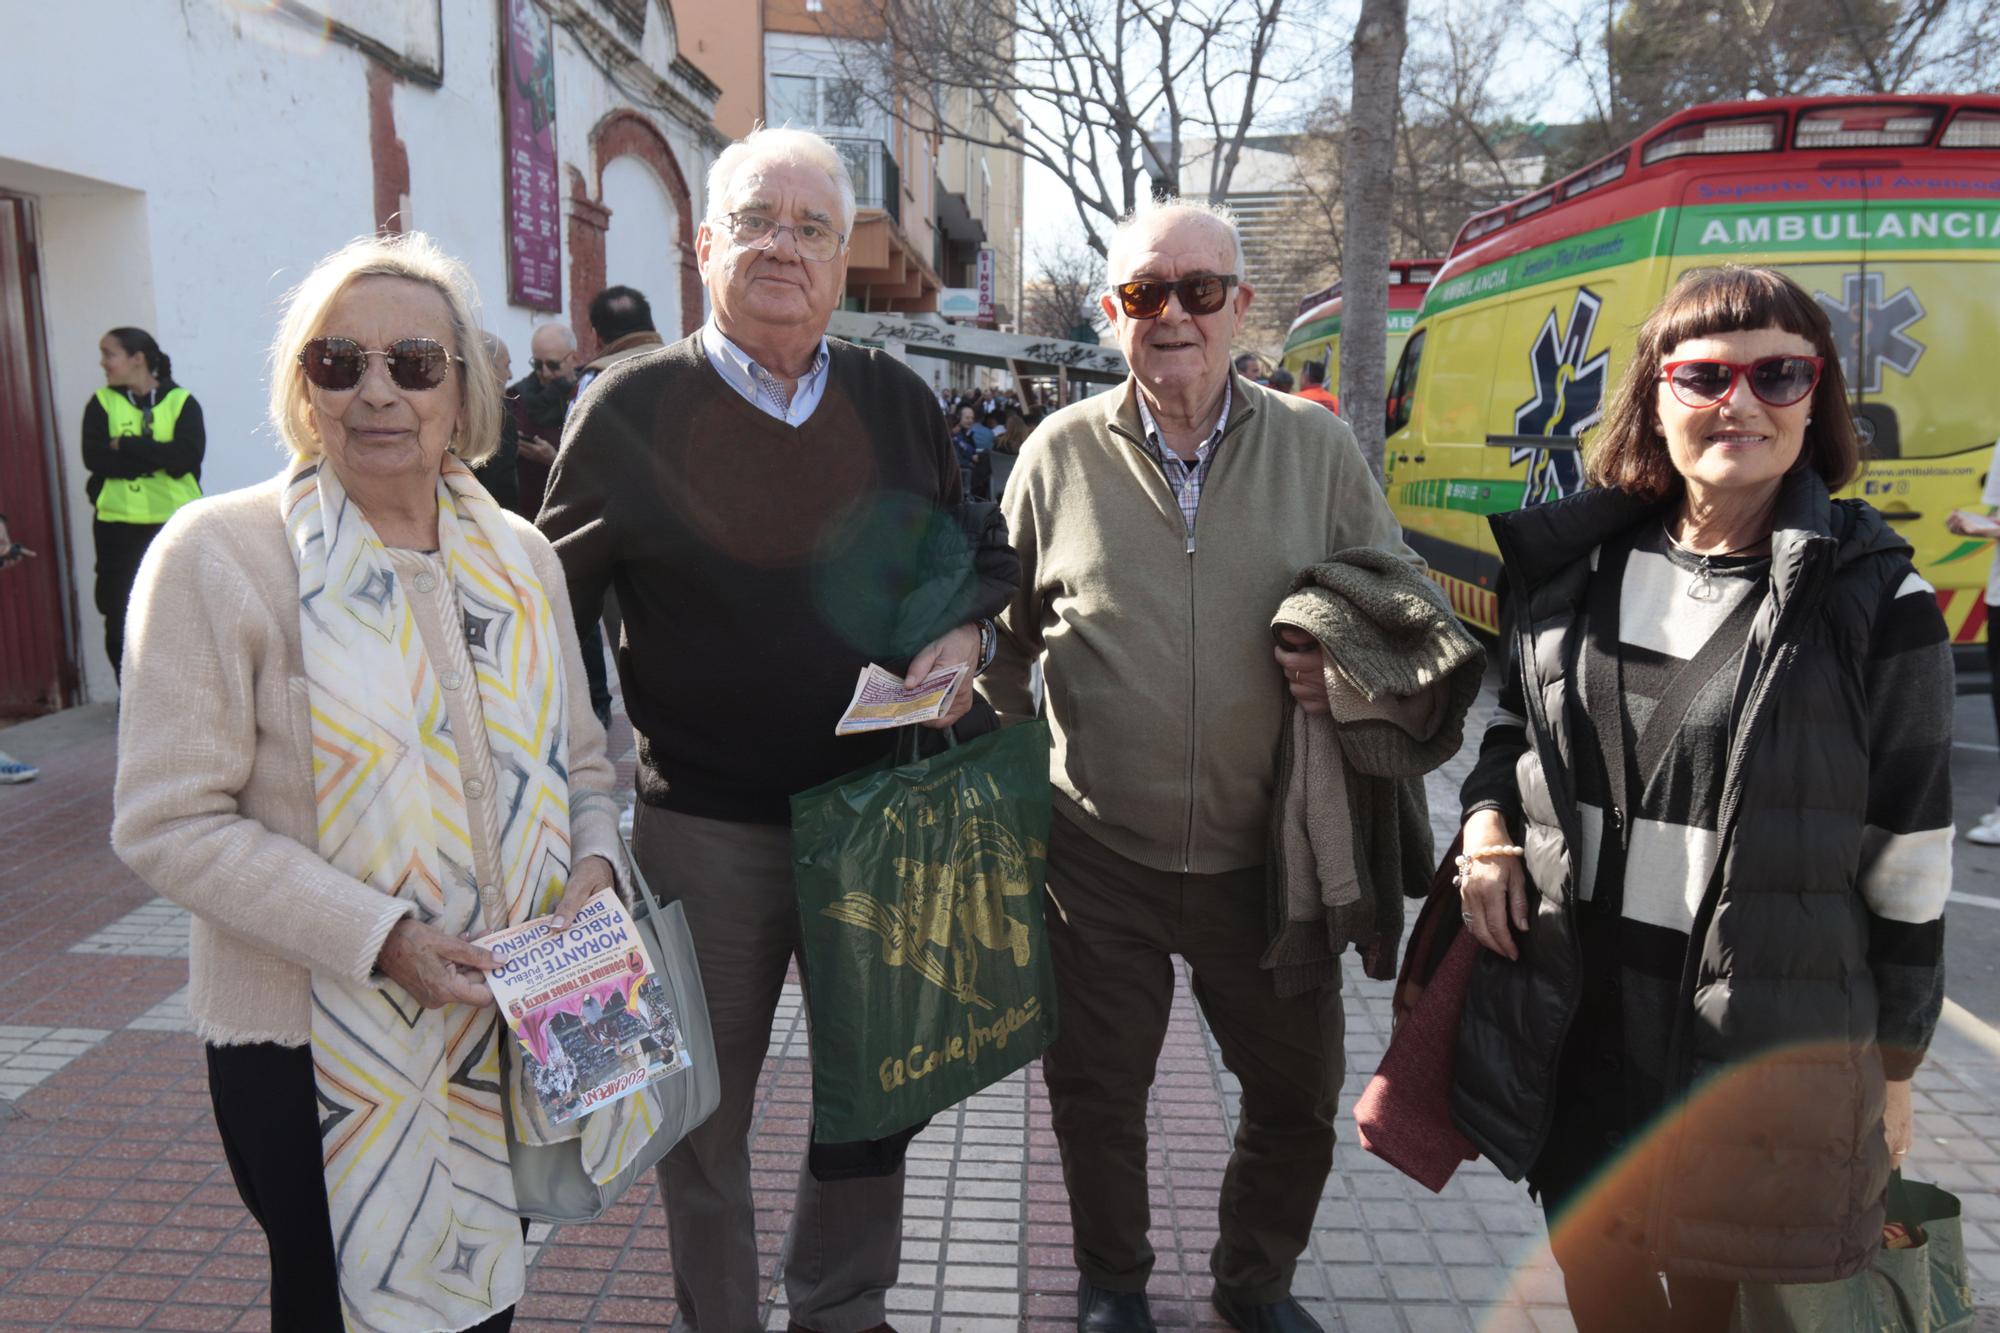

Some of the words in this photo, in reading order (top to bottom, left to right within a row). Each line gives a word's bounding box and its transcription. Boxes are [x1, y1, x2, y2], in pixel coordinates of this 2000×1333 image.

[980, 252, 989, 303] BINGO
[569, 910, 623, 941] PABLO
[573, 901, 605, 924] BRU
[492, 934, 564, 979] AGUADO
[542, 926, 628, 974] MORANTE
[628, 951, 640, 968] 7
[504, 965, 541, 986] PUEBLA
[577, 973, 591, 984] DE
[589, 958, 626, 980] CORRIDA
[550, 979, 580, 998] TOROS
[582, 1067, 646, 1107] BOCAIRENT
[879, 1056, 906, 1092] El
